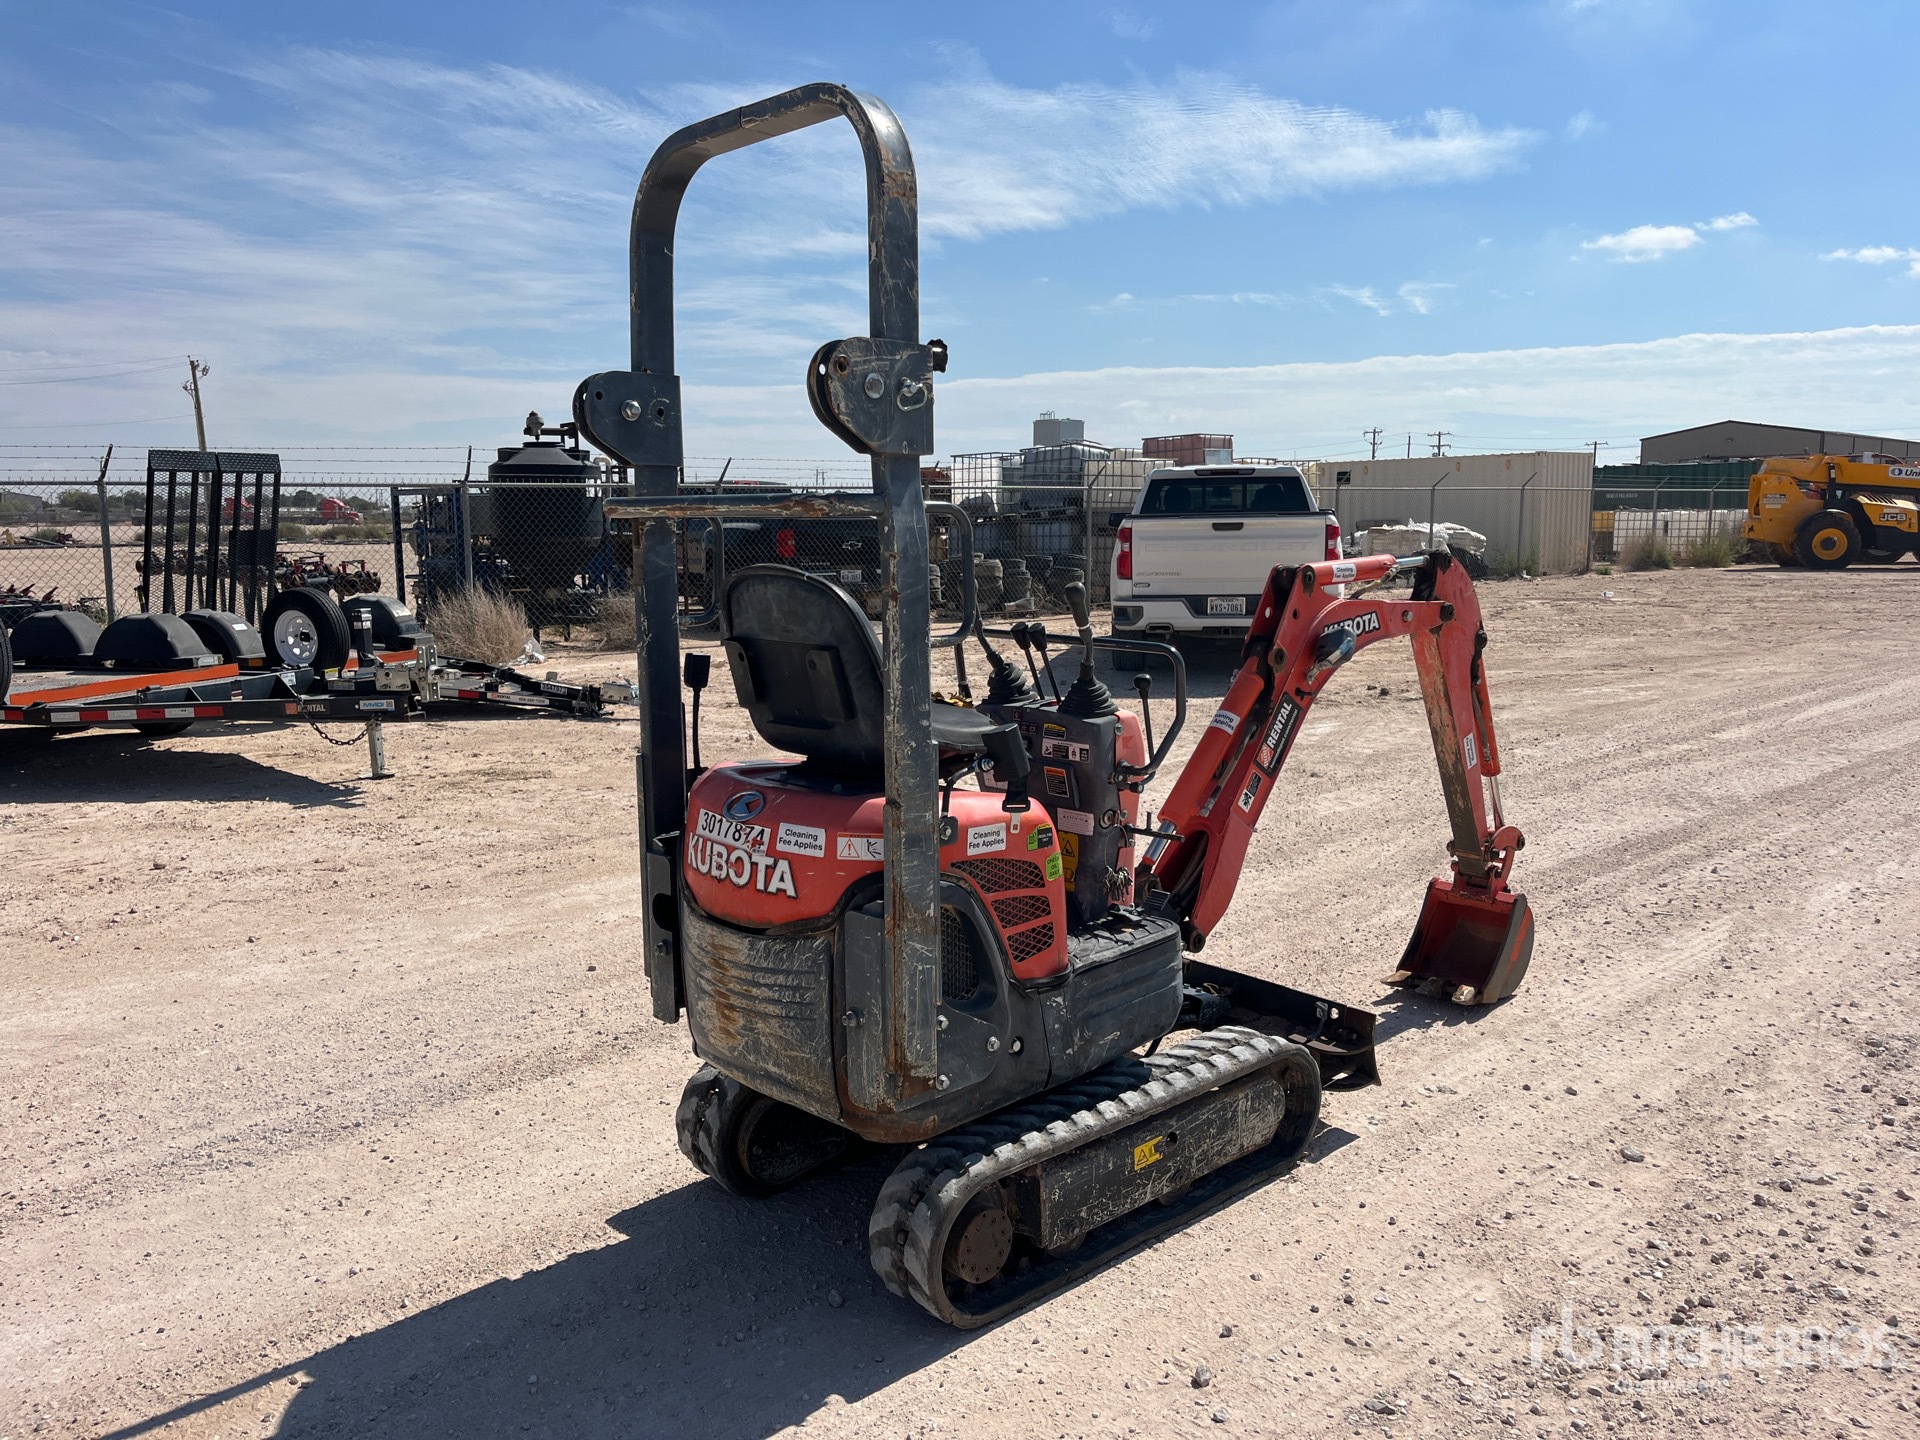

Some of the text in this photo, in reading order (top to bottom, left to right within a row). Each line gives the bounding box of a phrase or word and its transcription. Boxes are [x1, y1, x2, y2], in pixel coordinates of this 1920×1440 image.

[1879, 513, 1906, 521] JCB
[1144, 541, 1313, 552] CHEVROLET
[1266, 702, 1292, 749] RENTAL
[784, 828, 819, 842] Cleaning
[973, 830, 1001, 840] Cleaning
[778, 836, 823, 851] Fee Applies
[969, 838, 1005, 849] Fee Applies
[687, 831, 798, 899] KUBOTA
